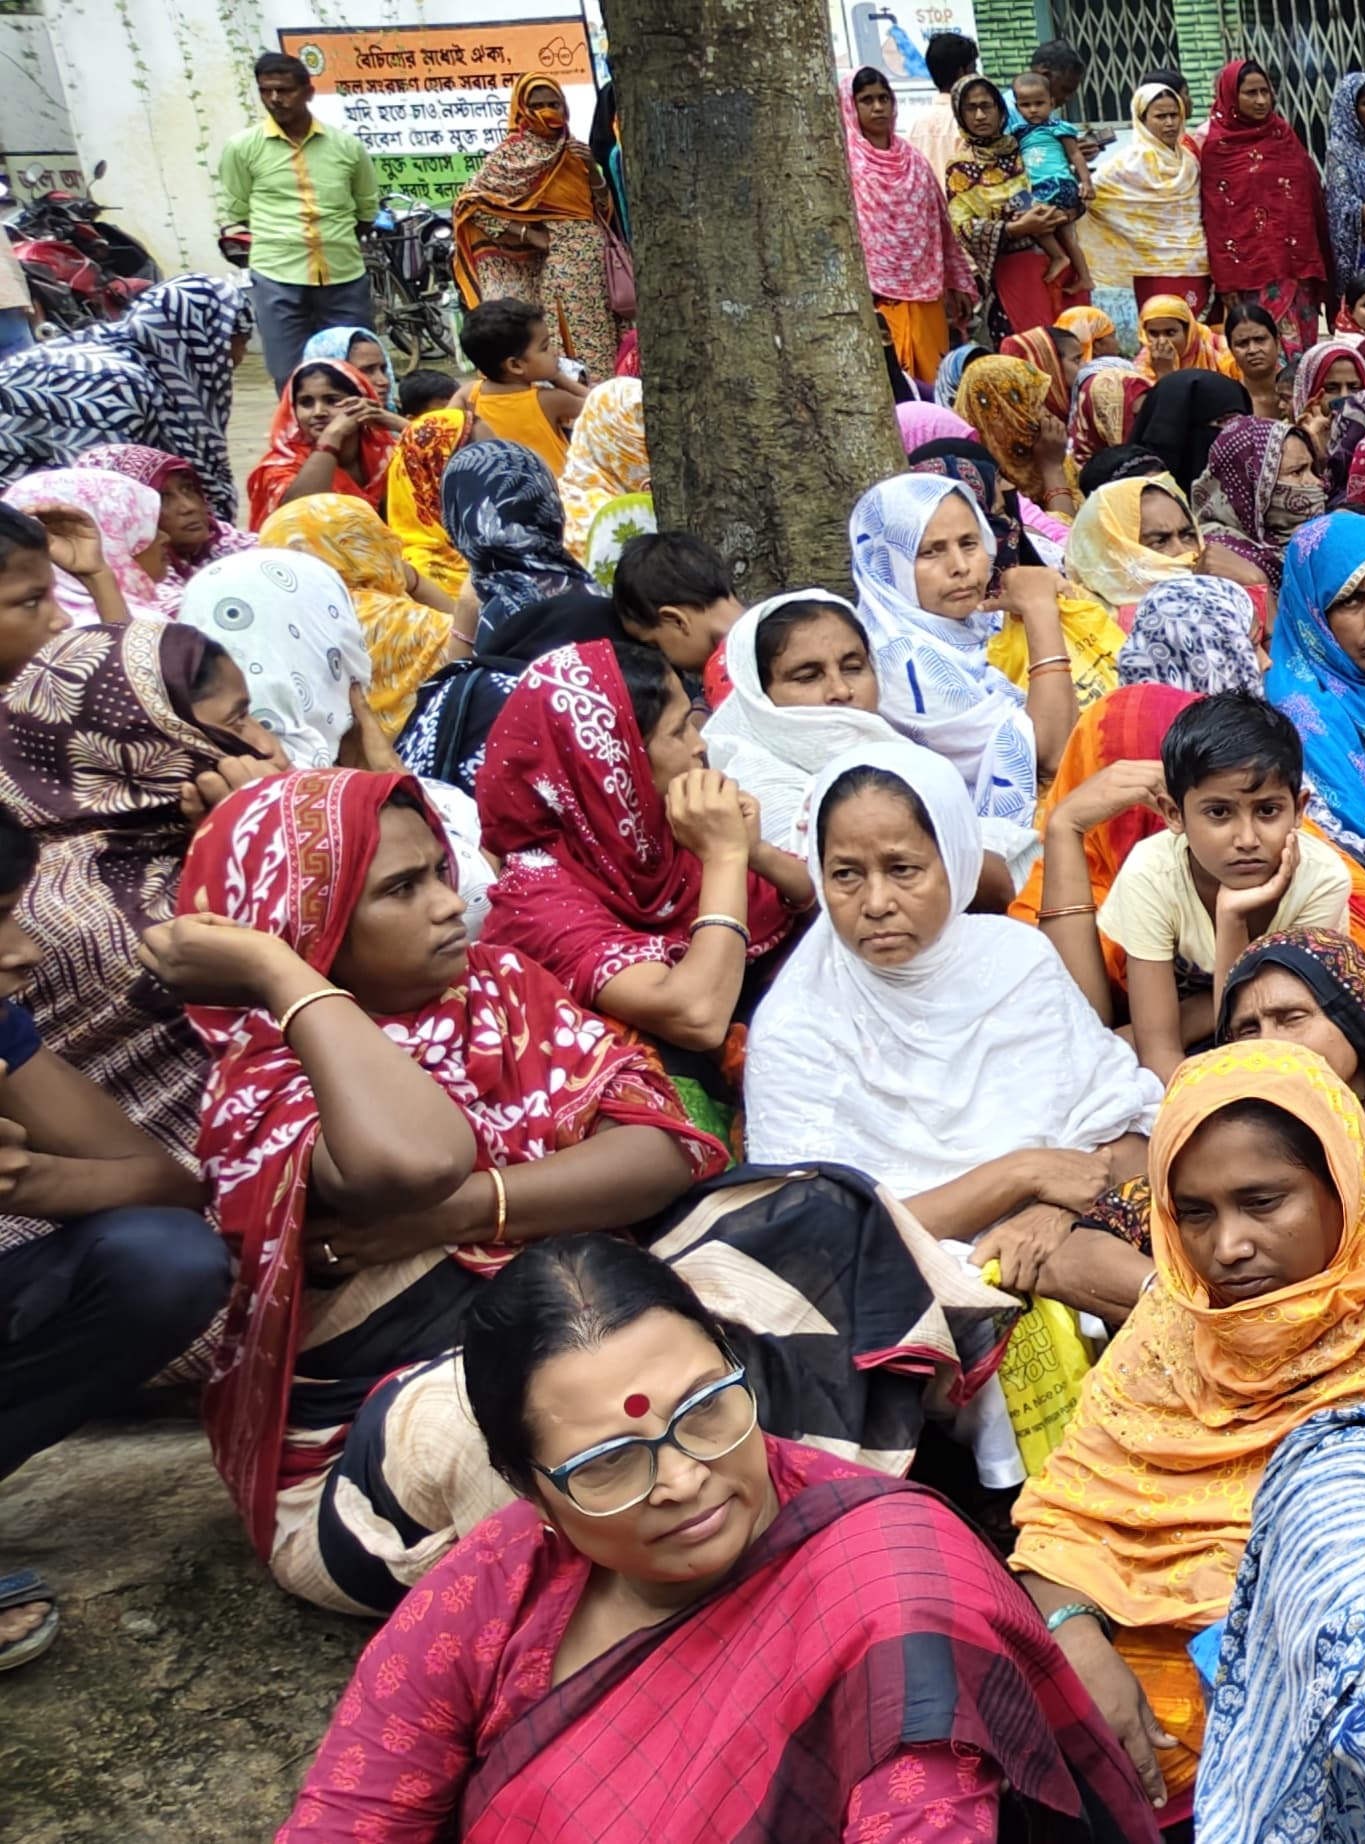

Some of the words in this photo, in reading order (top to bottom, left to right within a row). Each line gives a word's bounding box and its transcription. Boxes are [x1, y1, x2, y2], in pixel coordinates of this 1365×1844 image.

[915, 8, 953, 24] STOP
[334, 79, 364, 97] জল
[423, 76, 457, 94] হোক
[458, 73, 497, 92] সবার
[500, 72, 521, 89] ল
[344, 98, 374, 122] যদি
[376, 104, 407, 122] হতে
[409, 103, 439, 120] চাও
[439, 94, 511, 120] নস্টালজি
[353, 124, 403, 149] রিবেশ
[409, 129, 445, 147] হোক
[448, 128, 478, 153] মুক্ত
[1012, 1307, 1045, 1341] OU
[1008, 1346, 1059, 1392] YOU
[1023, 1403, 1033, 1414] A
